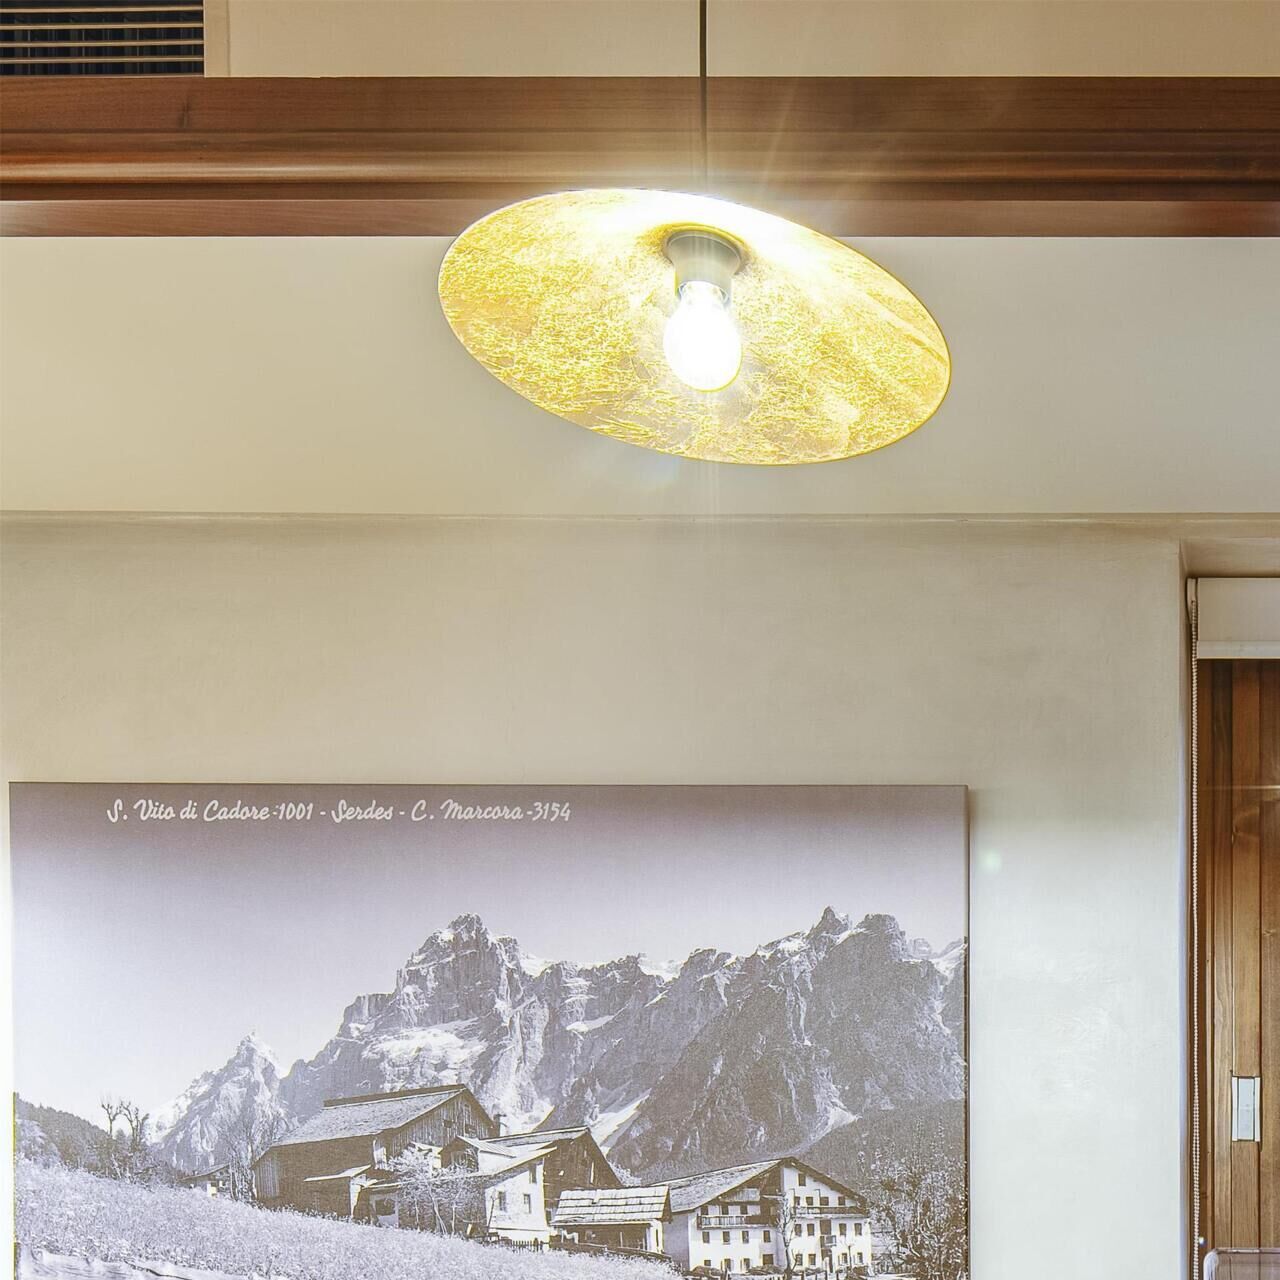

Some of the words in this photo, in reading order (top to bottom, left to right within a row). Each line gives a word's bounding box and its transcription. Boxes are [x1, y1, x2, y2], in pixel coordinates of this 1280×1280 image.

[106, 799, 128, 823] S.
[133, 799, 175, 821] Vito
[180, 799, 197, 820] di
[331, 800, 394, 823] Serdes
